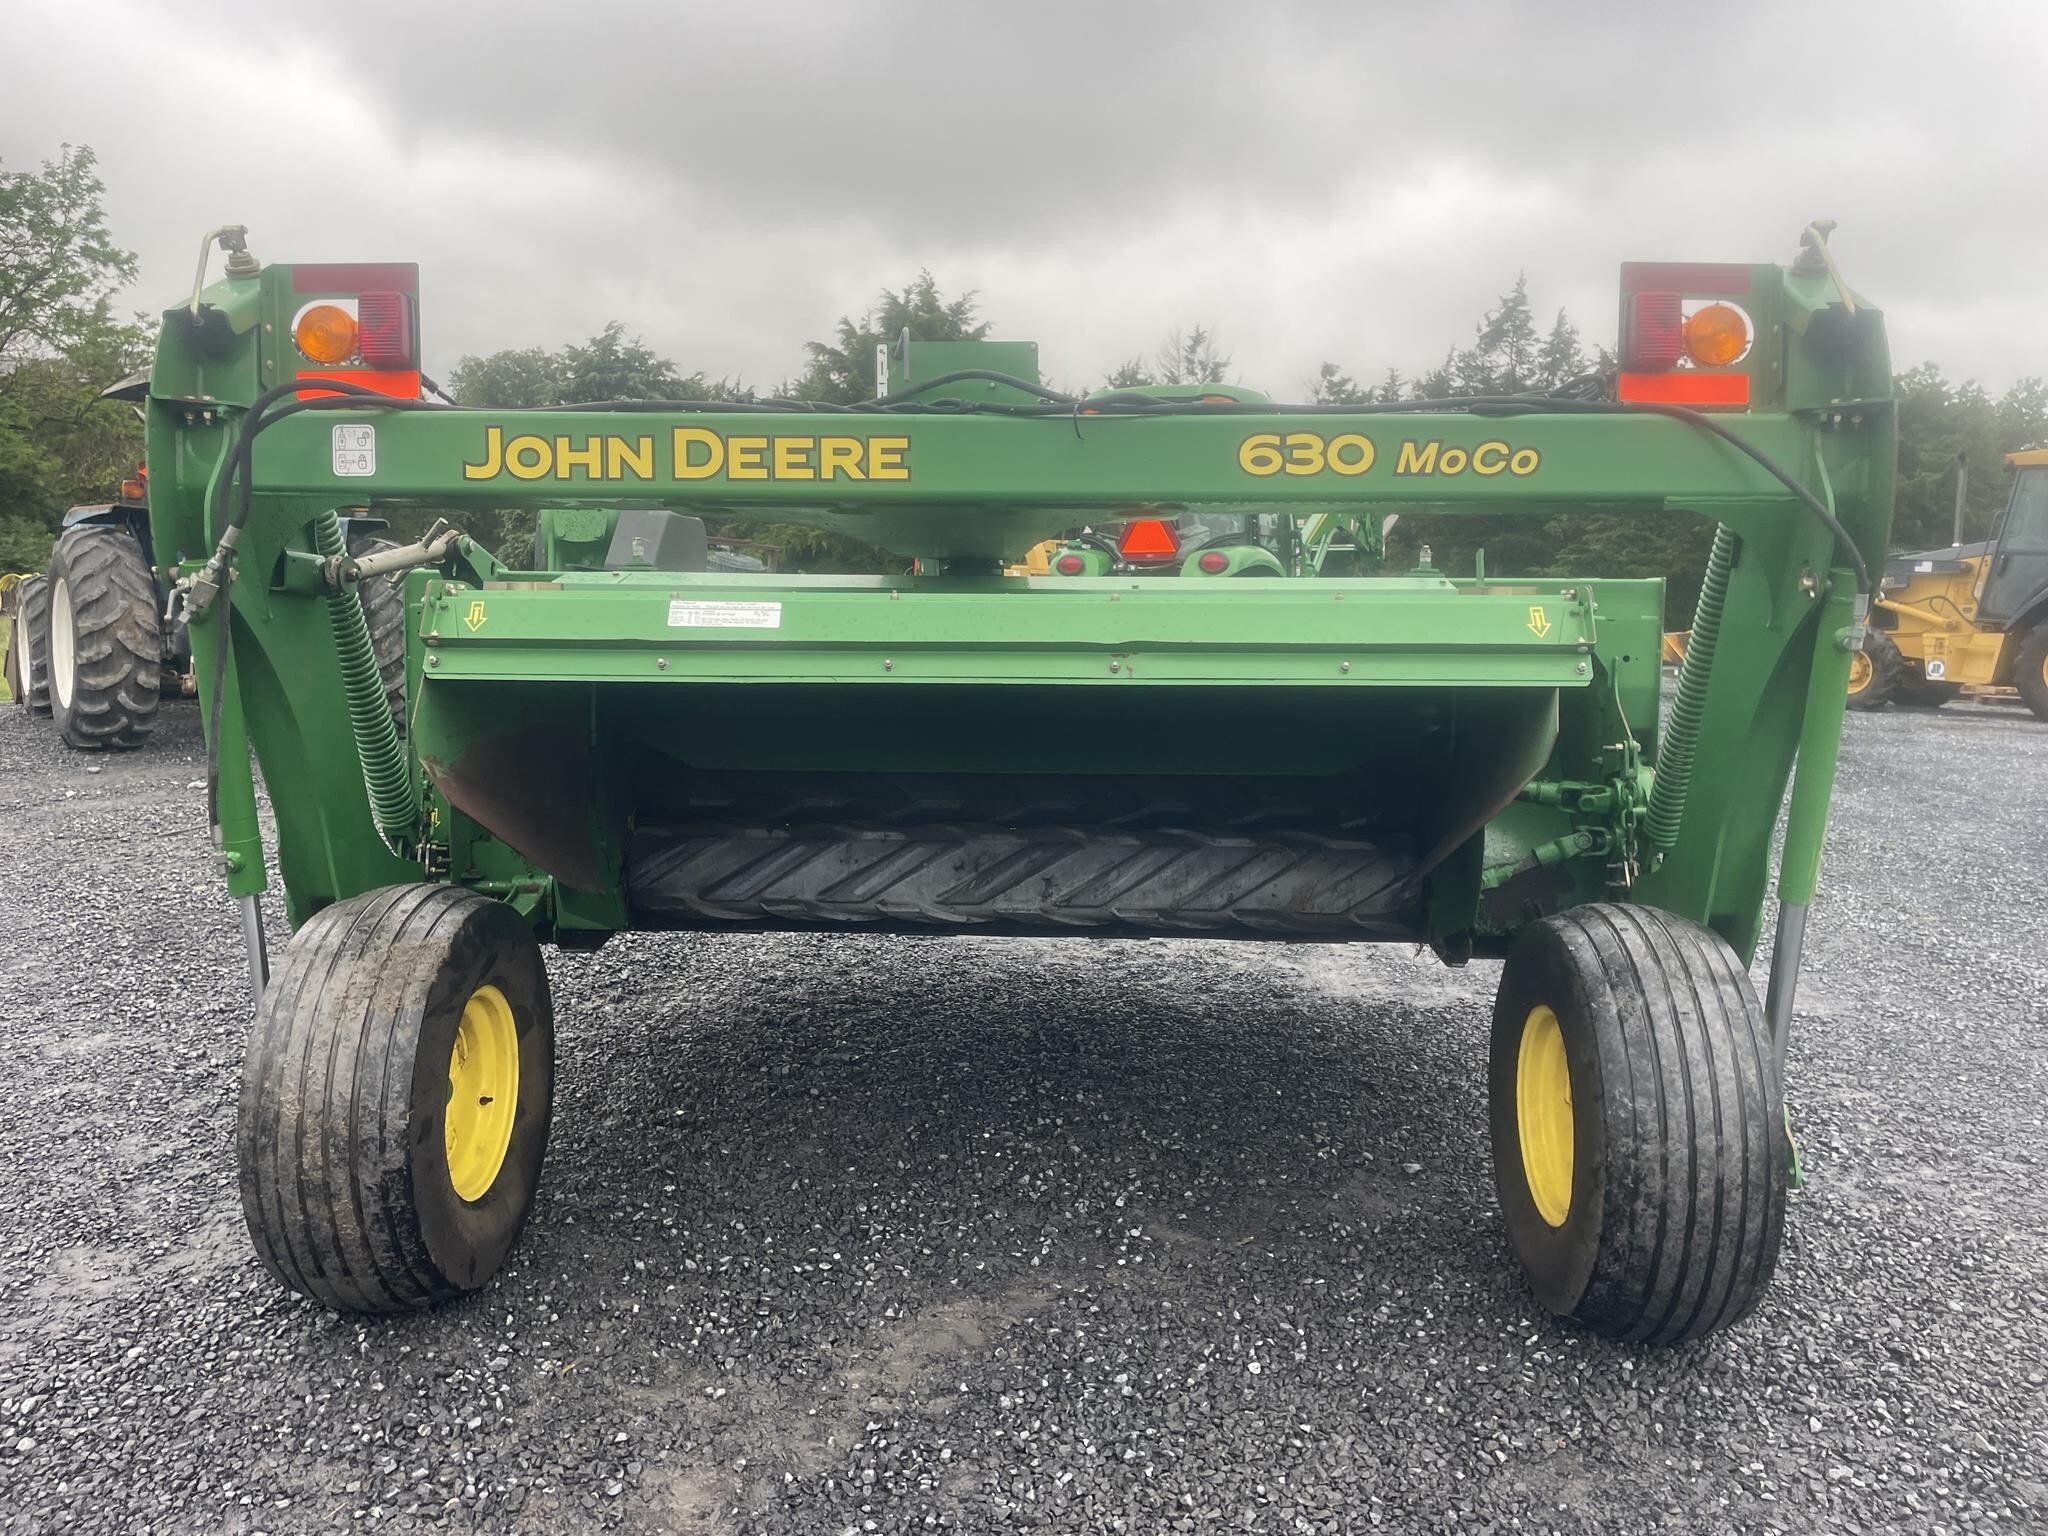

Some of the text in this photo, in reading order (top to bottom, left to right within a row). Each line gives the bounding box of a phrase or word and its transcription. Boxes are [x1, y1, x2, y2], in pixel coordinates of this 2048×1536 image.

[463, 425, 911, 481] JOHN DEERE
[1238, 431, 1541, 477] 630 MoCo
